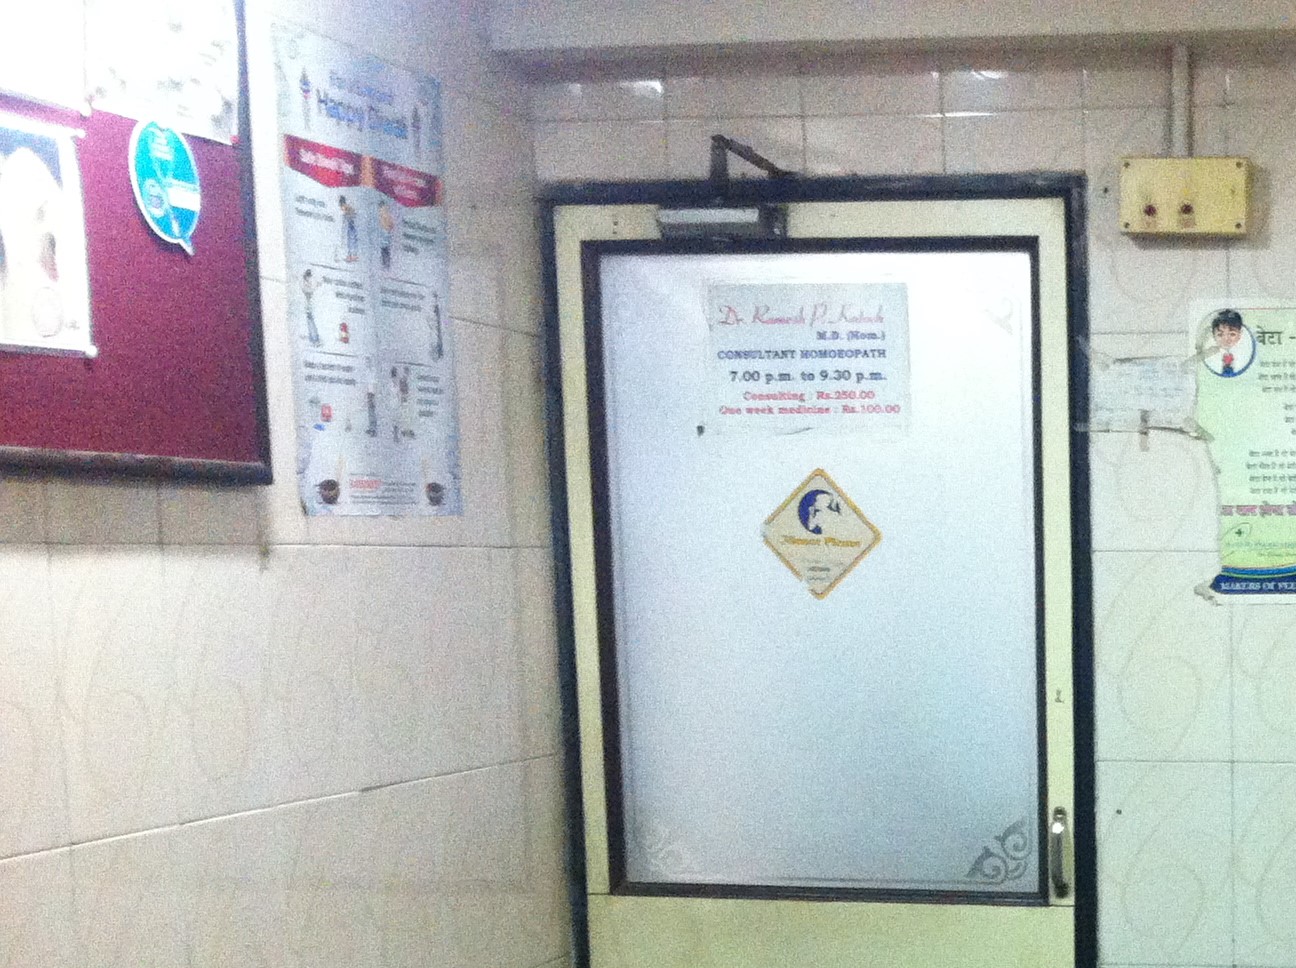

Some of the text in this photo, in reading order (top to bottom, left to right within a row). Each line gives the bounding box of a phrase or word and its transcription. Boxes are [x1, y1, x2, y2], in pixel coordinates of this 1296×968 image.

[1256, 325, 1283, 346] बेटा
[717, 349, 887, 360] CONSULTANT HOMOEOPATH
[729, 370, 888, 385] 7.00 p.m. to 9.30 p.m.
[743, 390, 806, 403] Consulting
[745, 404, 774, 415] week
[778, 404, 832, 415] medicine
